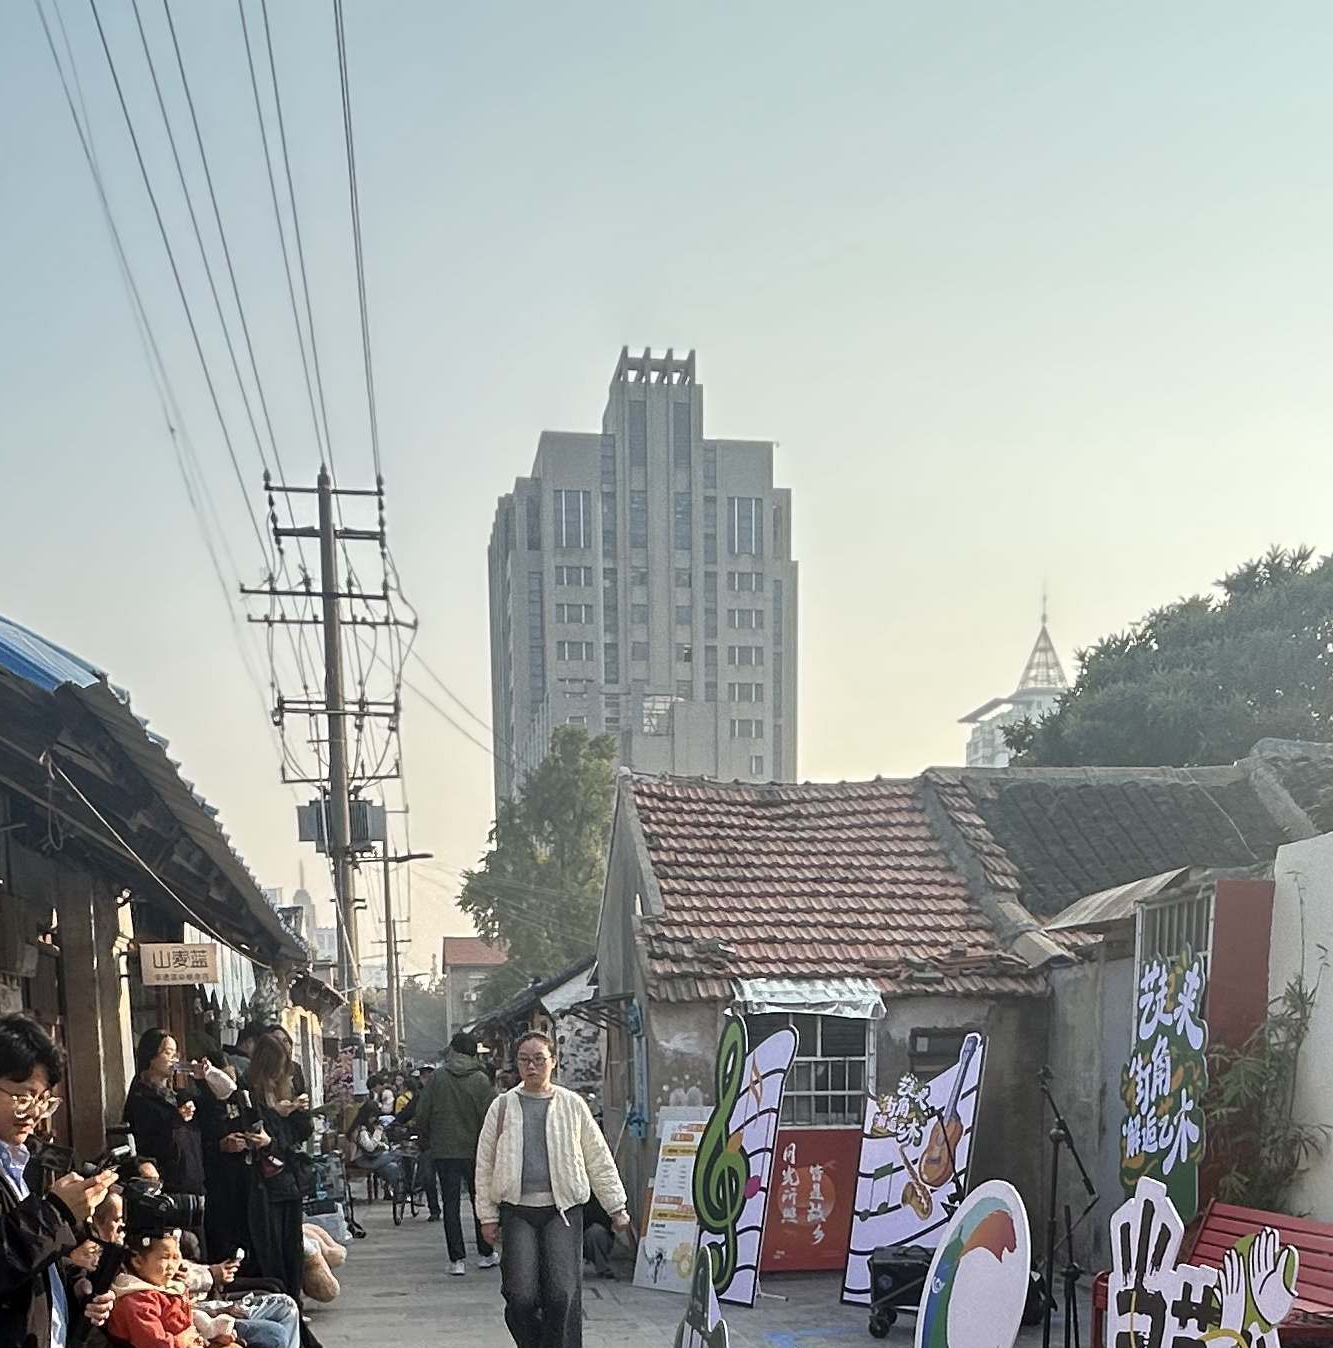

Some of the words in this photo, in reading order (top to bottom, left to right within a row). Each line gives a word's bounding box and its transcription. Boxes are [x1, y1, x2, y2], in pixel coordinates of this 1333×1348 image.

[1129, 1034, 1171, 1116] 街角
[781, 1142, 800, 1224] 月光所照
[806, 1163, 826, 1245] 皆是故乡
